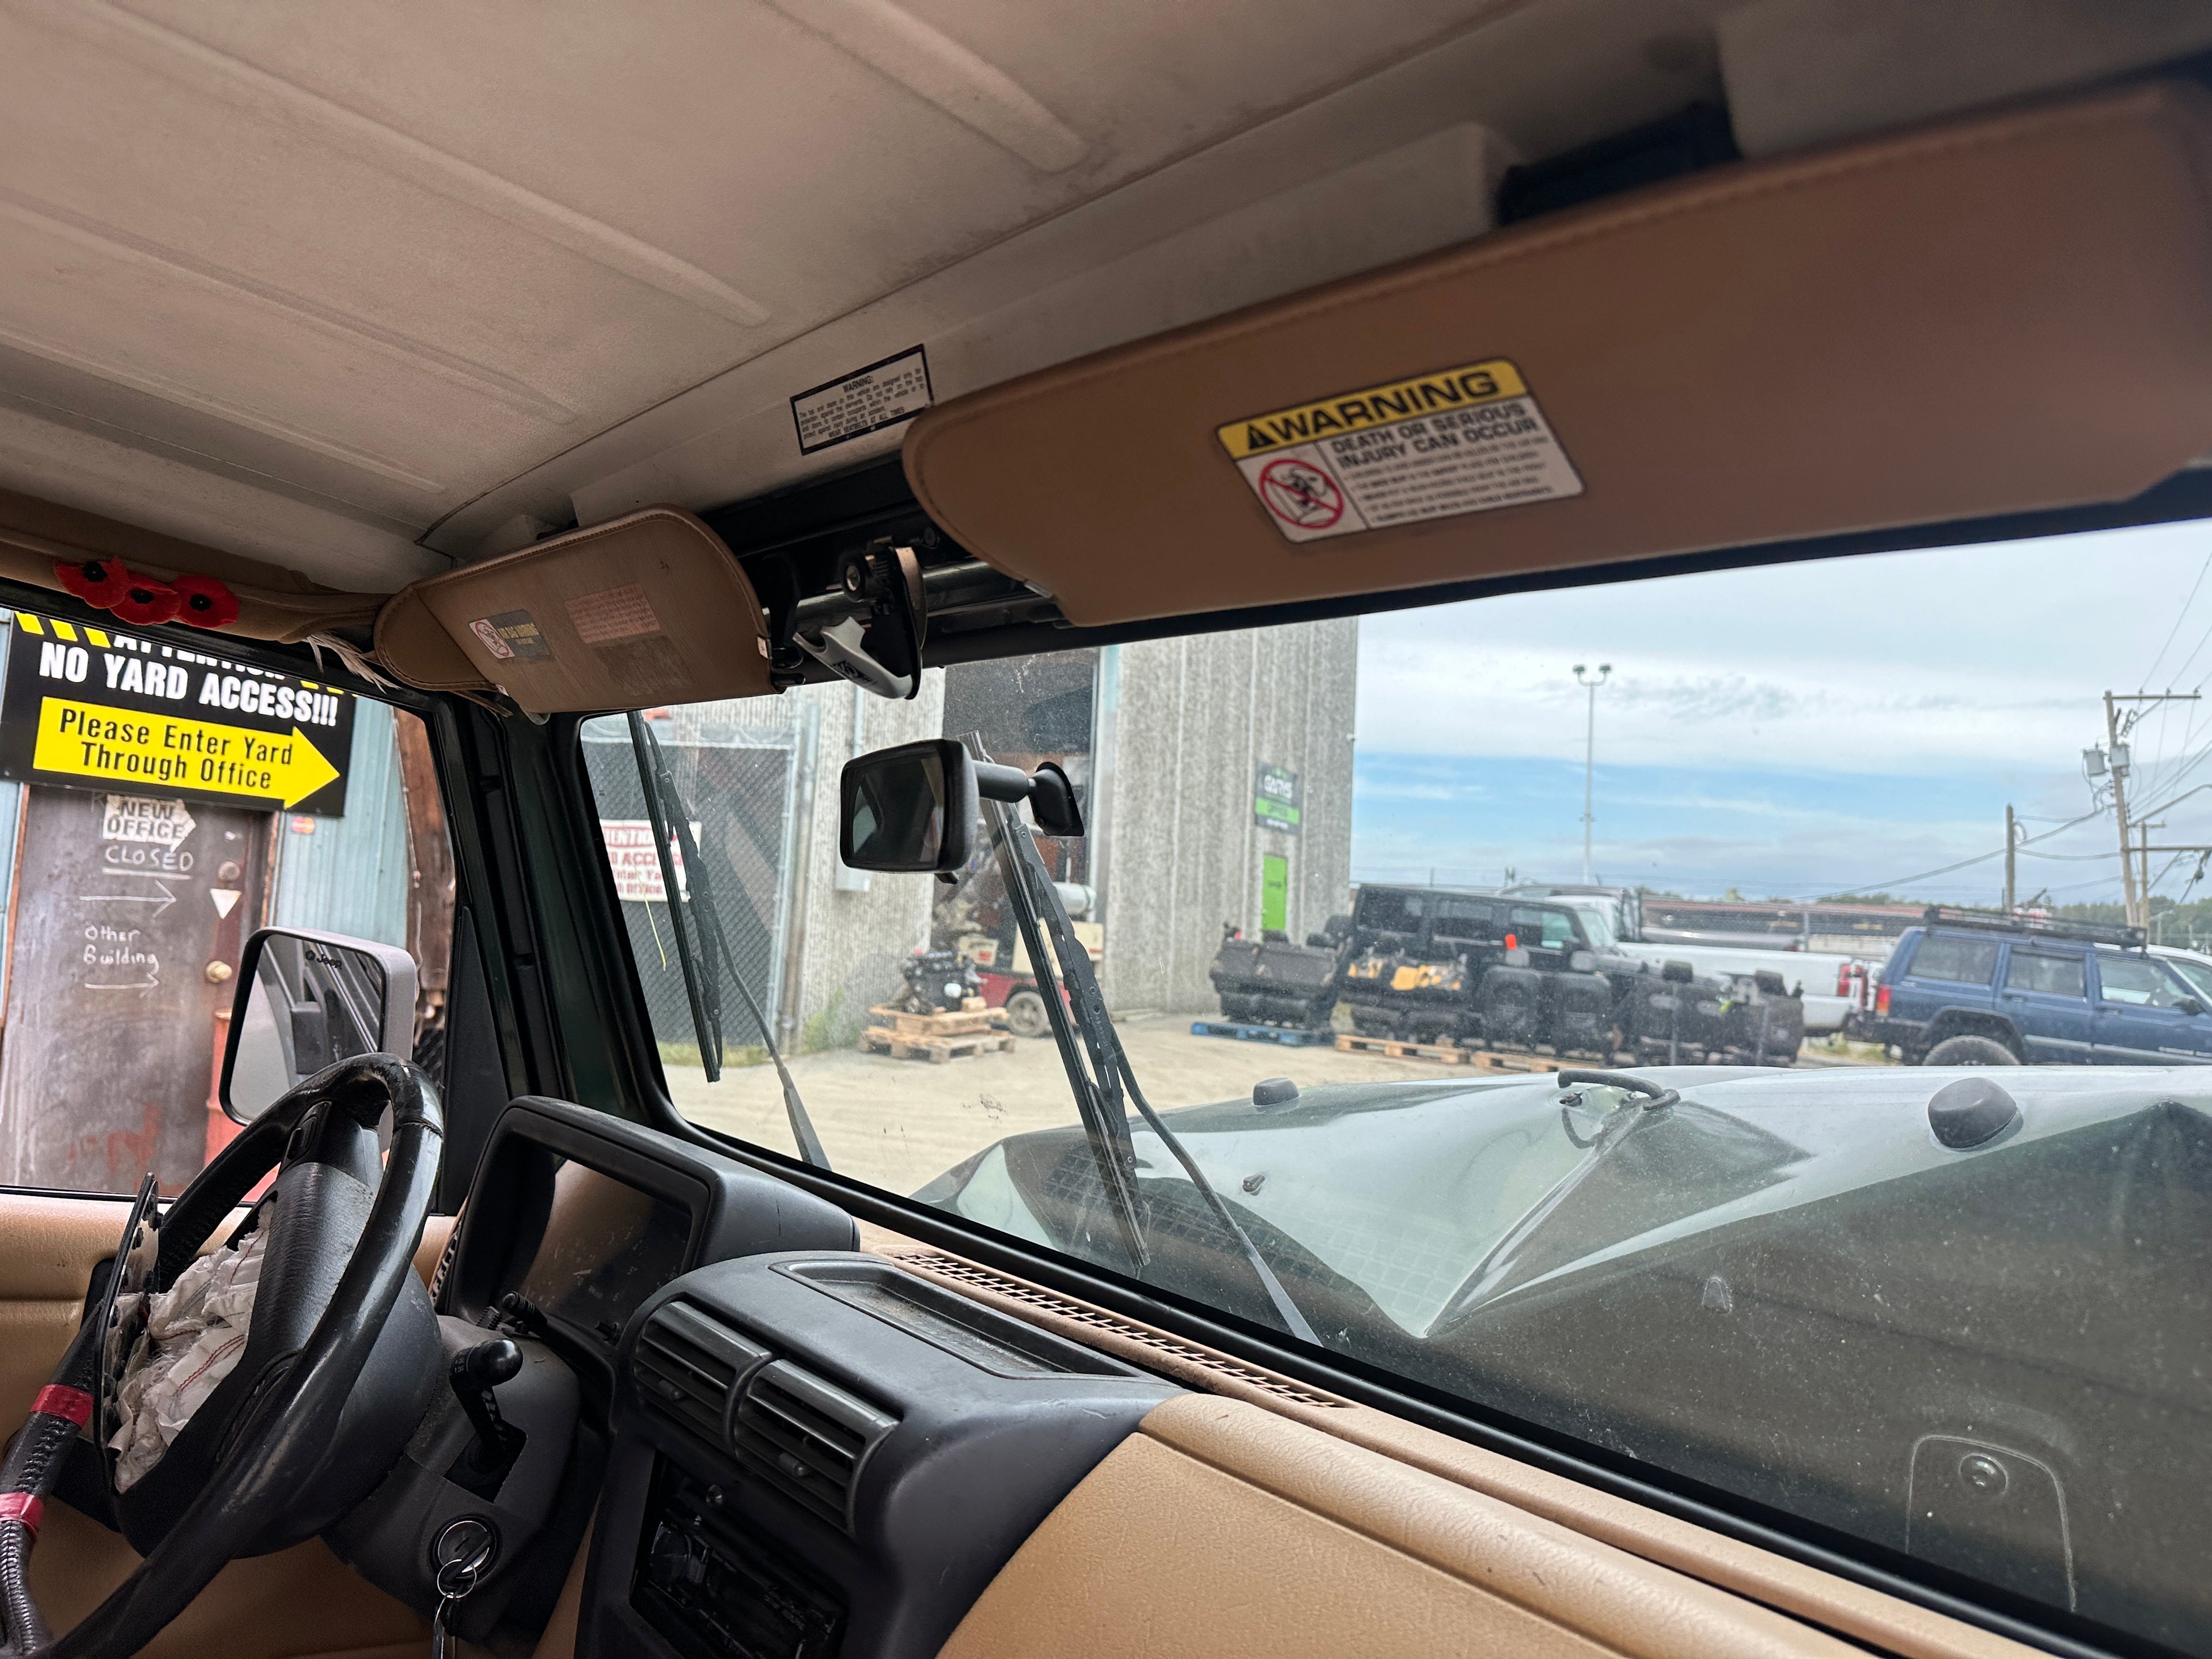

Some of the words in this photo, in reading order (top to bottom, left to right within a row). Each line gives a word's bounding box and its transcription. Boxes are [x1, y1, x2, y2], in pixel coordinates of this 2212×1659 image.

[843, 376, 873, 393] WARNING:
[1269, 371, 1499, 442] WARNING
[1331, 430, 1396, 453] DEATH
[1398, 423, 1427, 439] OR
[1431, 403, 1525, 432] SERIOUS
[1336, 443, 1407, 469] INJURY
[1412, 433, 1459, 453] CAN
[1461, 418, 1537, 443] OCCUR
[39, 641, 89, 683] NO
[103, 653, 189, 700] YARD
[198, 672, 339, 727] ACCESS!!!
[60, 708, 150, 745] Please
[164, 724, 231, 756] Enter
[245, 736, 293, 765] Yard
[81, 741, 187, 781] Through
[200, 758, 271, 790] Office
[107, 815, 185, 839] OFFICE
[120, 800, 173, 820] NEW
[105, 844, 194, 872] CLOSED
[84, 944, 160, 975] Building
[316, 954, 342, 969] Jeep
